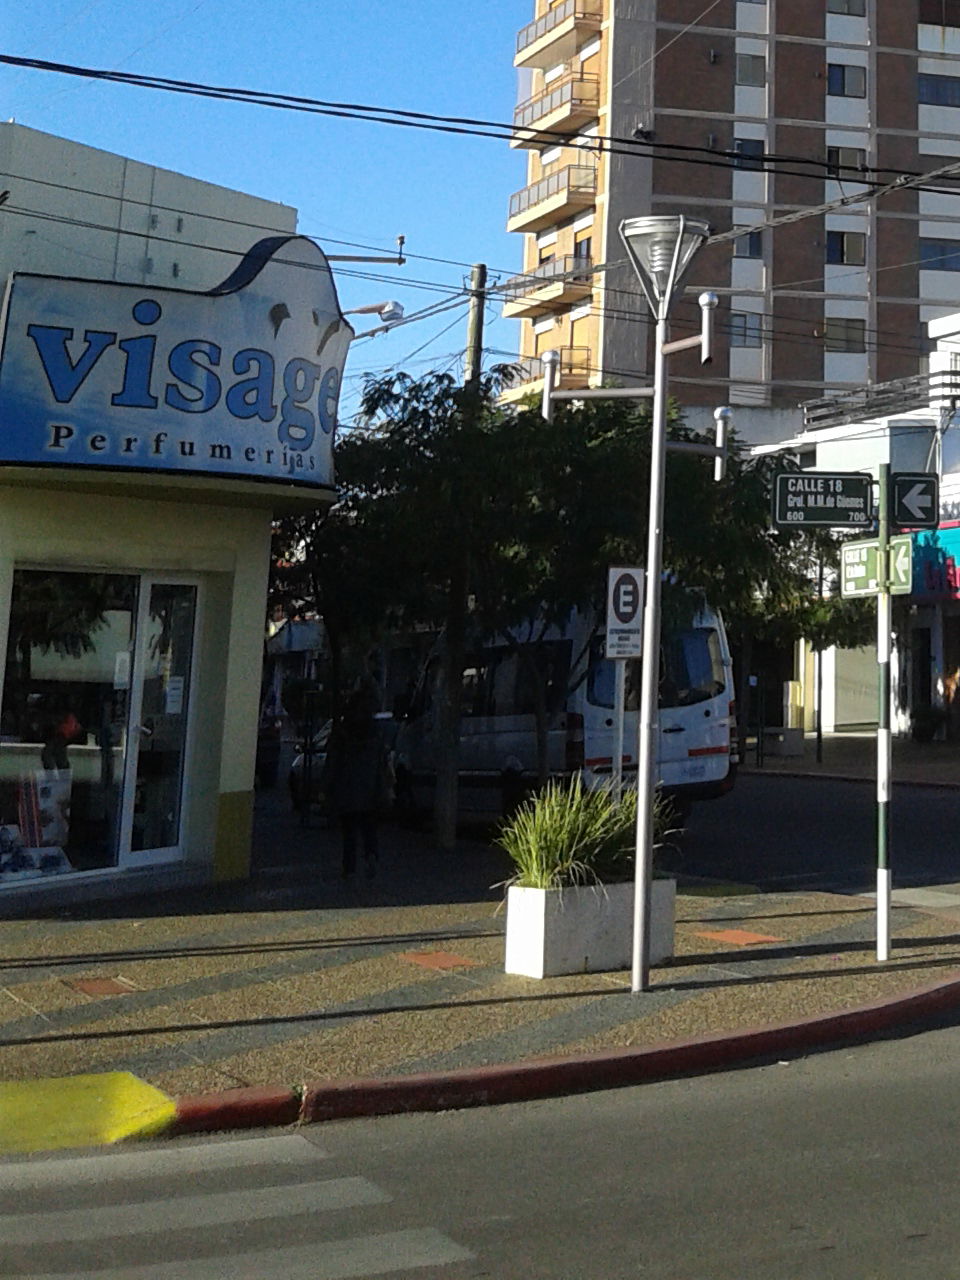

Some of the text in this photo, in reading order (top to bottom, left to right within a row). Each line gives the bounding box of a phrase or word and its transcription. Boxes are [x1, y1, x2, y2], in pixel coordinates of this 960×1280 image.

[27, 298, 340, 451] visage
[49, 424, 316, 471] Perfumerías
[787, 478, 843, 493] CALLE 18
[786, 511, 866, 522] 600 700
[620, 584, 633, 613] E
